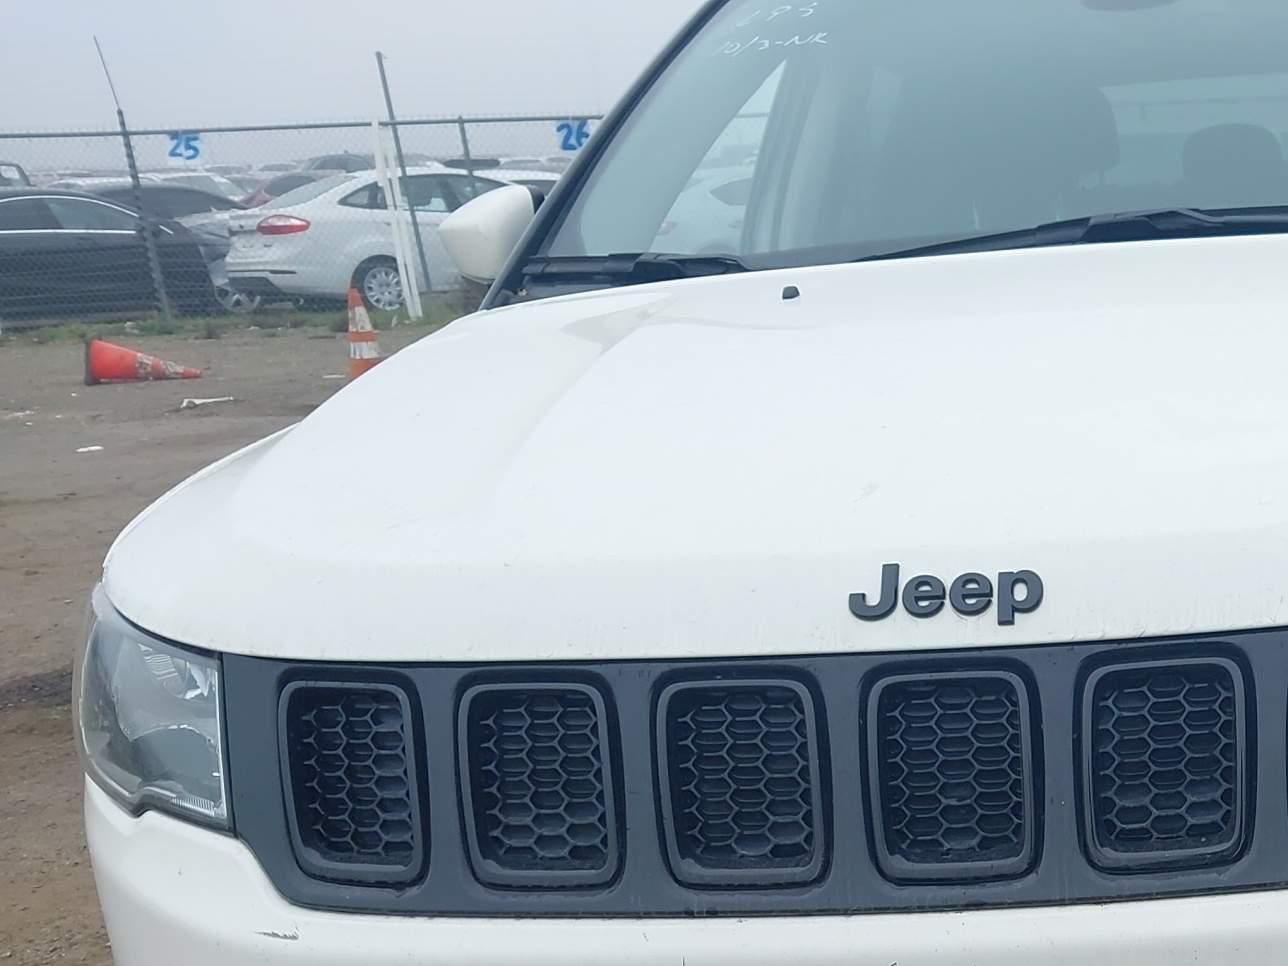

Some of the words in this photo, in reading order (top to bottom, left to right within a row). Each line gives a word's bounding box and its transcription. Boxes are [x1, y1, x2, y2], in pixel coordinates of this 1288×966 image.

[168, 133, 201, 160] 25
[556, 119, 591, 151] 26
[848, 563, 1044, 626] Jeep
